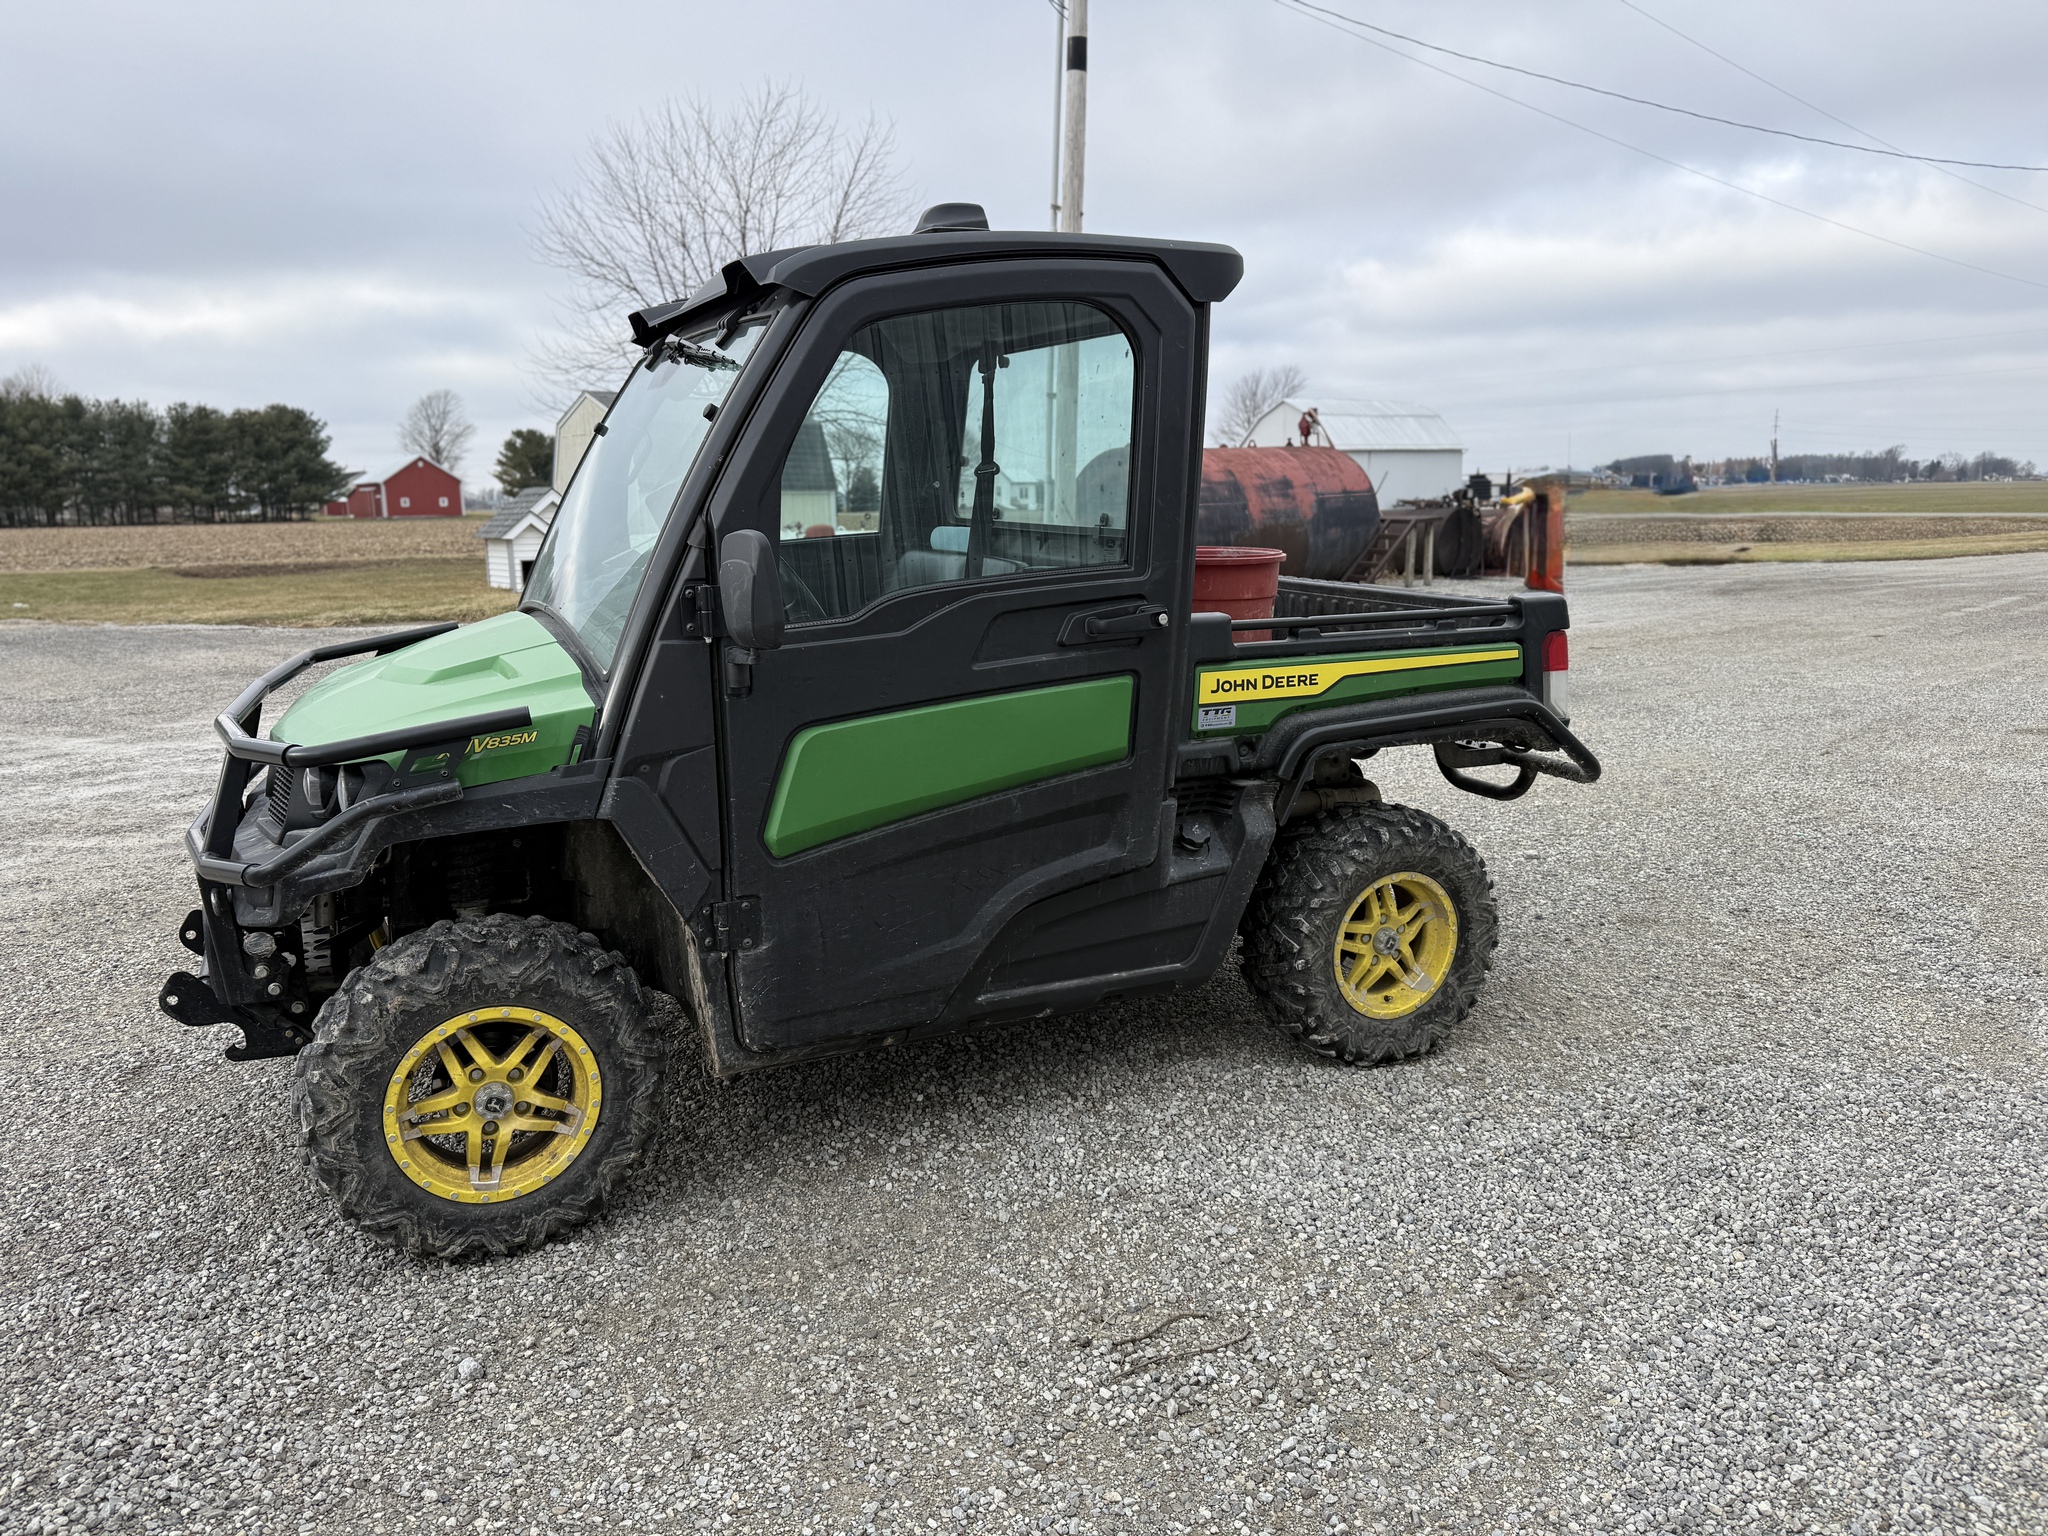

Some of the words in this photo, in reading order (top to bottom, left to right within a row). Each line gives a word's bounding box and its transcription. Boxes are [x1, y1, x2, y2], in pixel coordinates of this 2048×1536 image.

[1211, 678, 1257, 694] JOHN
[1262, 674, 1319, 689] DEERE
[436, 731, 538, 760] V835M
